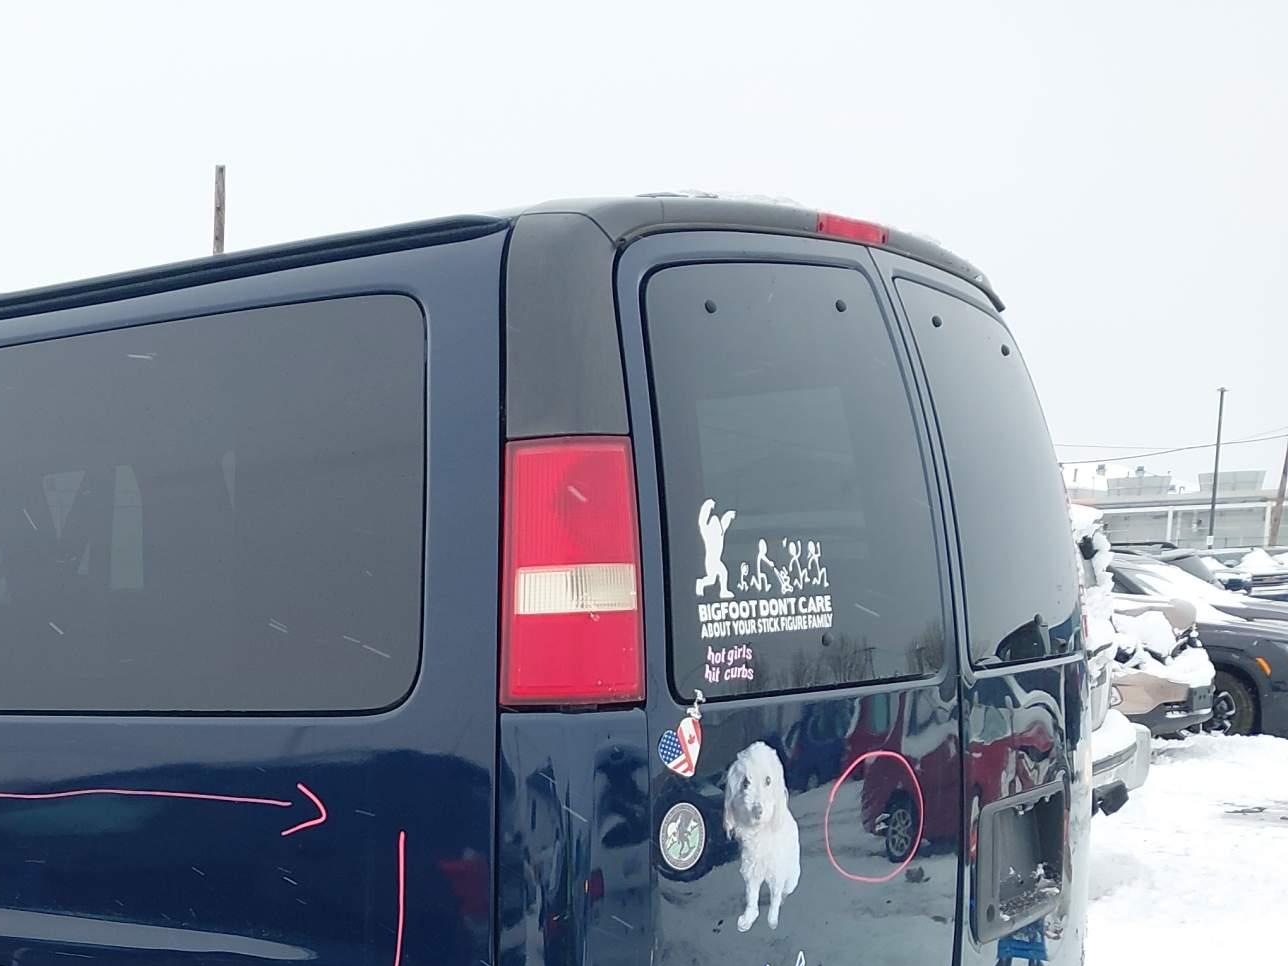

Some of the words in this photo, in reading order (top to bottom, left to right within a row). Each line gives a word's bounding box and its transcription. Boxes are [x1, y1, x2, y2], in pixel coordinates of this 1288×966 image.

[698, 600, 758, 622] BIGFOOT
[759, 597, 797, 617] DON'T
[798, 595, 833, 613] CARE
[701, 621, 731, 639] ABOUT
[732, 619, 757, 636] YOUR
[757, 617, 781, 634] STICK
[781, 615, 808, 631] FIGURE
[808, 613, 833, 628] FAMILY
[707, 645, 726, 664] hot
[727, 644, 753, 666] girls
[704, 664, 721, 683] hit
[724, 664, 754, 681] curbs
